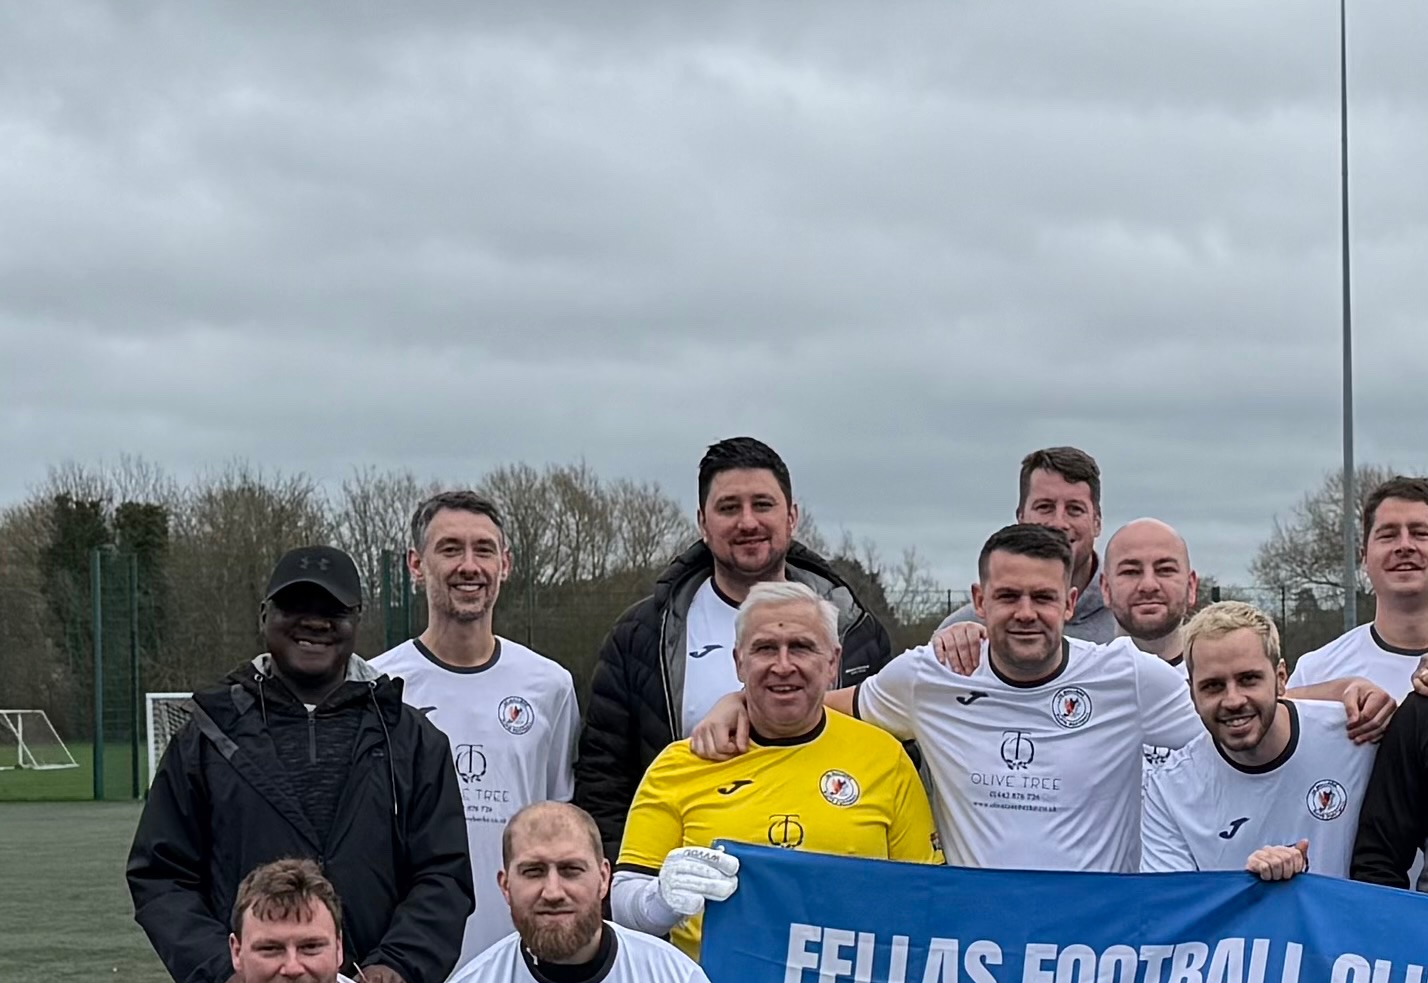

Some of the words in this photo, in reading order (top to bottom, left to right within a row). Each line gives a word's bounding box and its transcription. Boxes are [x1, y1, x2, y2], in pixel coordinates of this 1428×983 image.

[970, 772, 1016, 787] OLIVE
[1022, 776, 1062, 791] TREE
[475, 788, 510, 802] TREE
